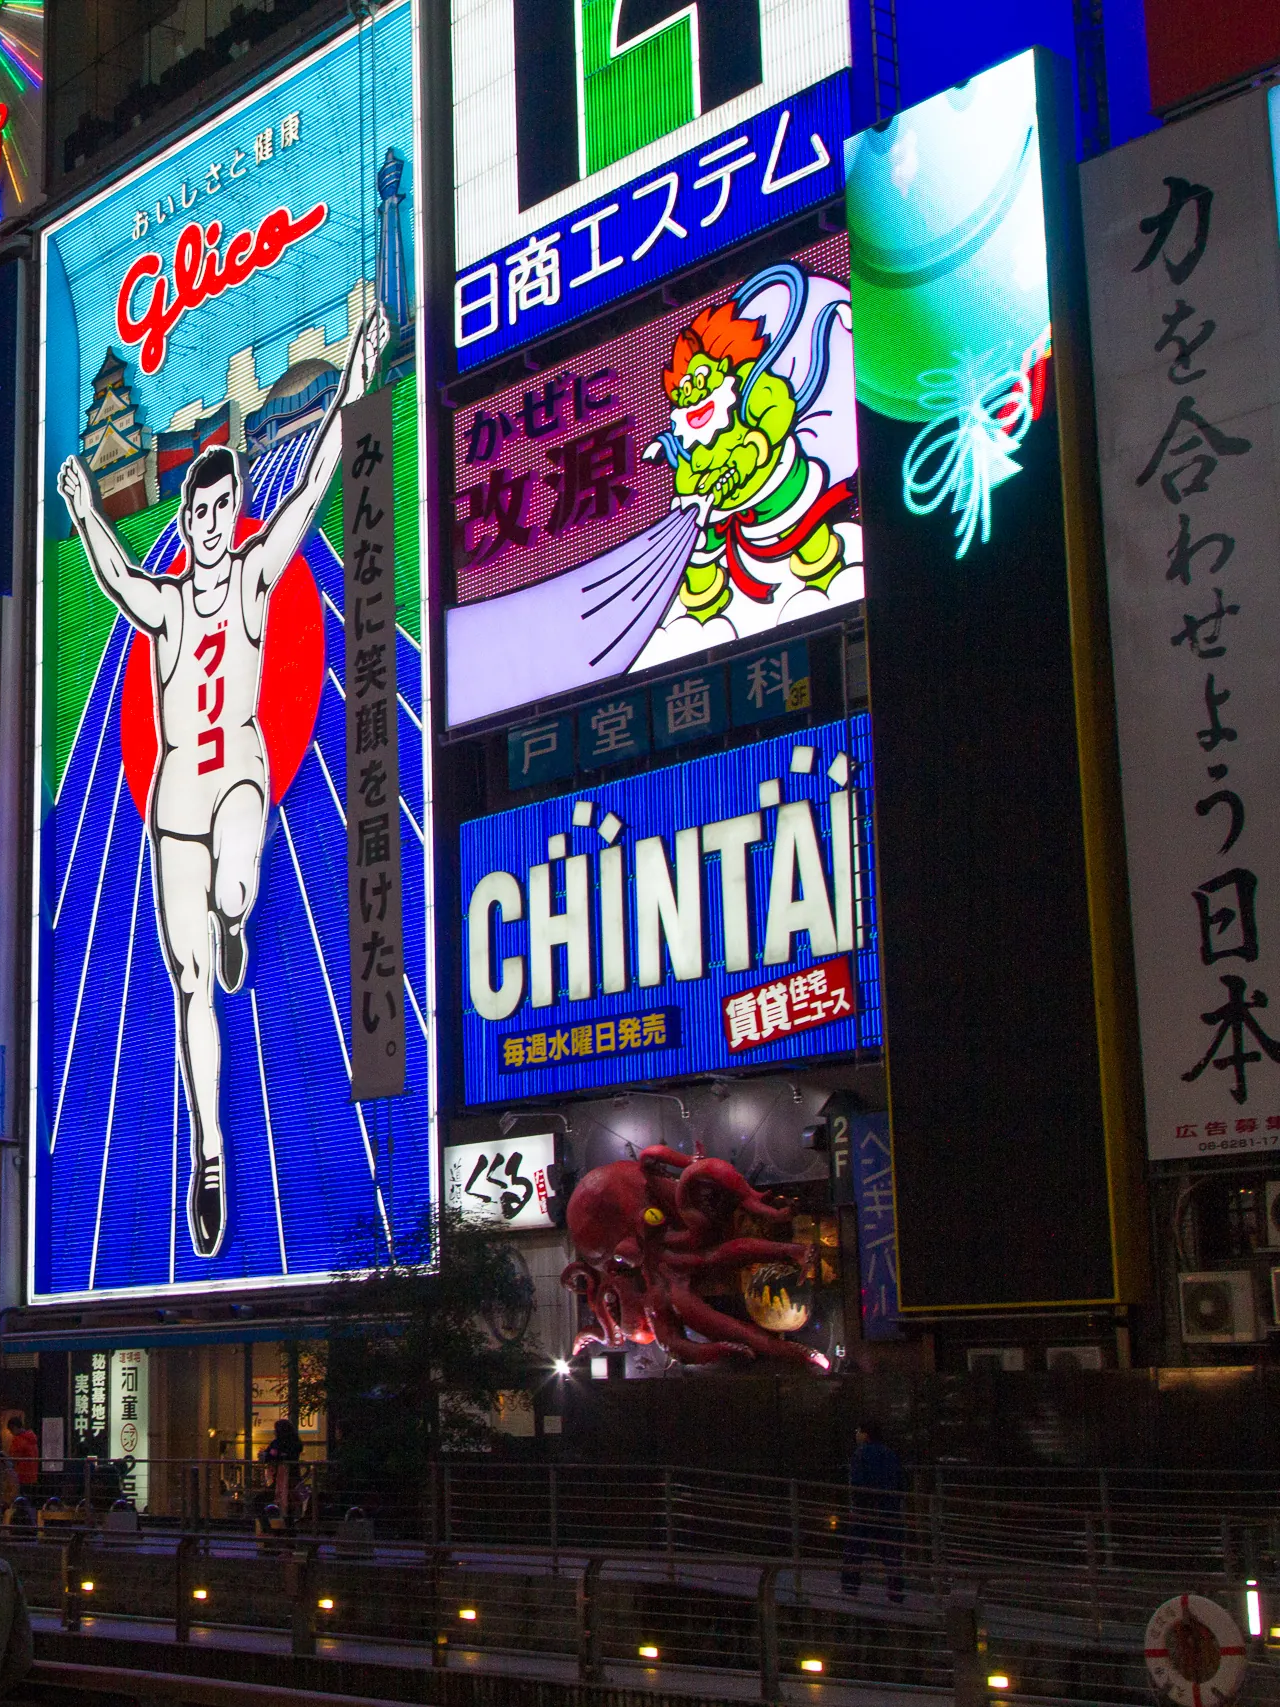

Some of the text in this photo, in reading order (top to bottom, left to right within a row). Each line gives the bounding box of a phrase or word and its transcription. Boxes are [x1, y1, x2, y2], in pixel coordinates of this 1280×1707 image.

[132, 110, 300, 240] おいしさと健康
[454, 110, 831, 348] 日商エステム
[115, 201, 328, 375] Glico
[465, 366, 620, 464] かぜに
[455, 414, 640, 571] 改源
[1131, 176, 1280, 1105] 力を合わせよう日本
[193, 620, 228, 776] グリコ
[725, 983, 790, 1048] 賃貸
[790, 970, 827, 1001] 住宅
[793, 985, 850, 1029] ニュース
[503, 1013, 666, 1068] 毎週水曜日発売
[464, 1151, 533, 1220] くくる
[832, 1116, 849, 1177] 2F
[121, 1367, 138, 1420] 河童
